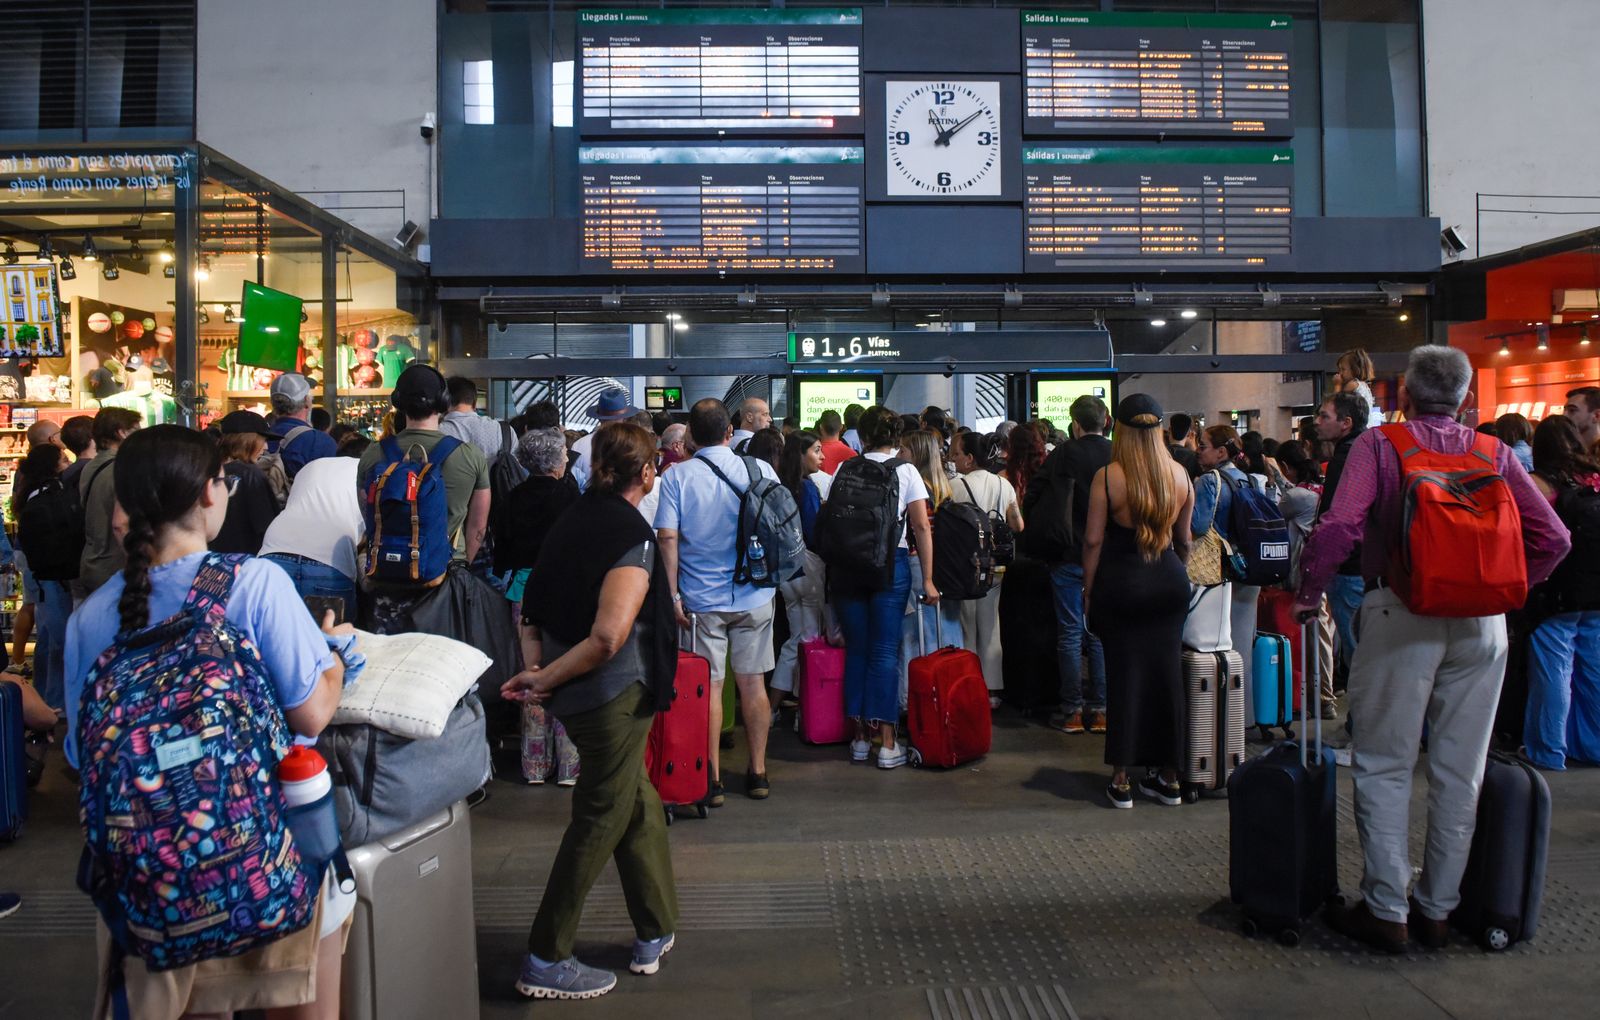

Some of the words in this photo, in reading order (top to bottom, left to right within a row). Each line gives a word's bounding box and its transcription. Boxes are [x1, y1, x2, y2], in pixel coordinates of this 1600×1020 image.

[582, 13, 618, 22] Llegadas
[1025, 14, 1054, 23] Salidas
[932, 90, 955, 105] 12
[895, 131, 910, 146] 9
[977, 131, 992, 146] 3
[1026, 151, 1055, 160] Salidas
[937, 172, 952, 187] 6
[821, 337, 834, 357] 1
[838, 347, 846, 357] a
[849, 337, 863, 357] 6
[868, 336, 890, 348] Vías
[807, 396, 825, 406] ¡400
[1263, 545, 1288, 558] PUMA
[192, 576, 227, 599] OSITIVITY
